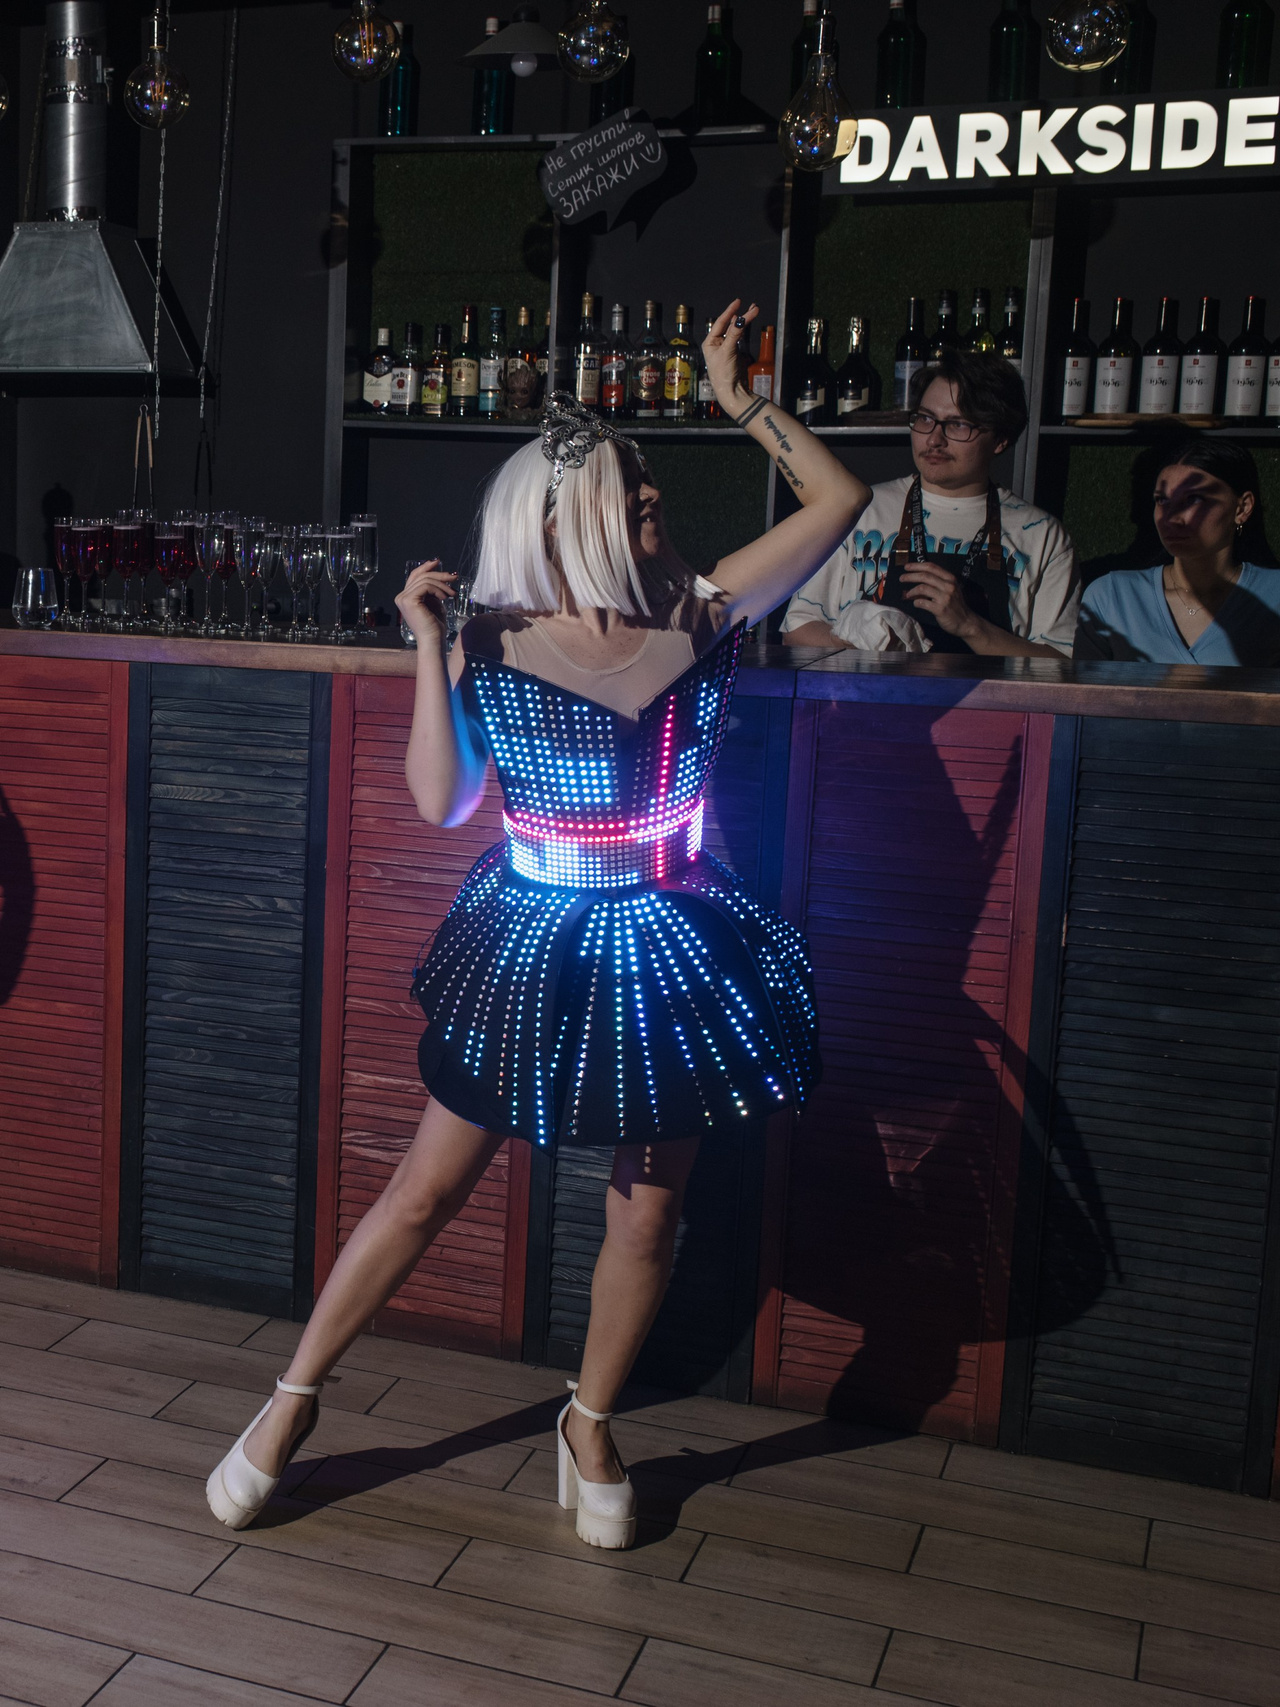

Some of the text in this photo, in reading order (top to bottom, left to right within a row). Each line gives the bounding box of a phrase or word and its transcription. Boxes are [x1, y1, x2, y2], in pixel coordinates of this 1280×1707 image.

[544, 156, 567, 175] Не
[839, 96, 1280, 184] DARKSIDE
[559, 153, 640, 219] ЗАКАЖИ
